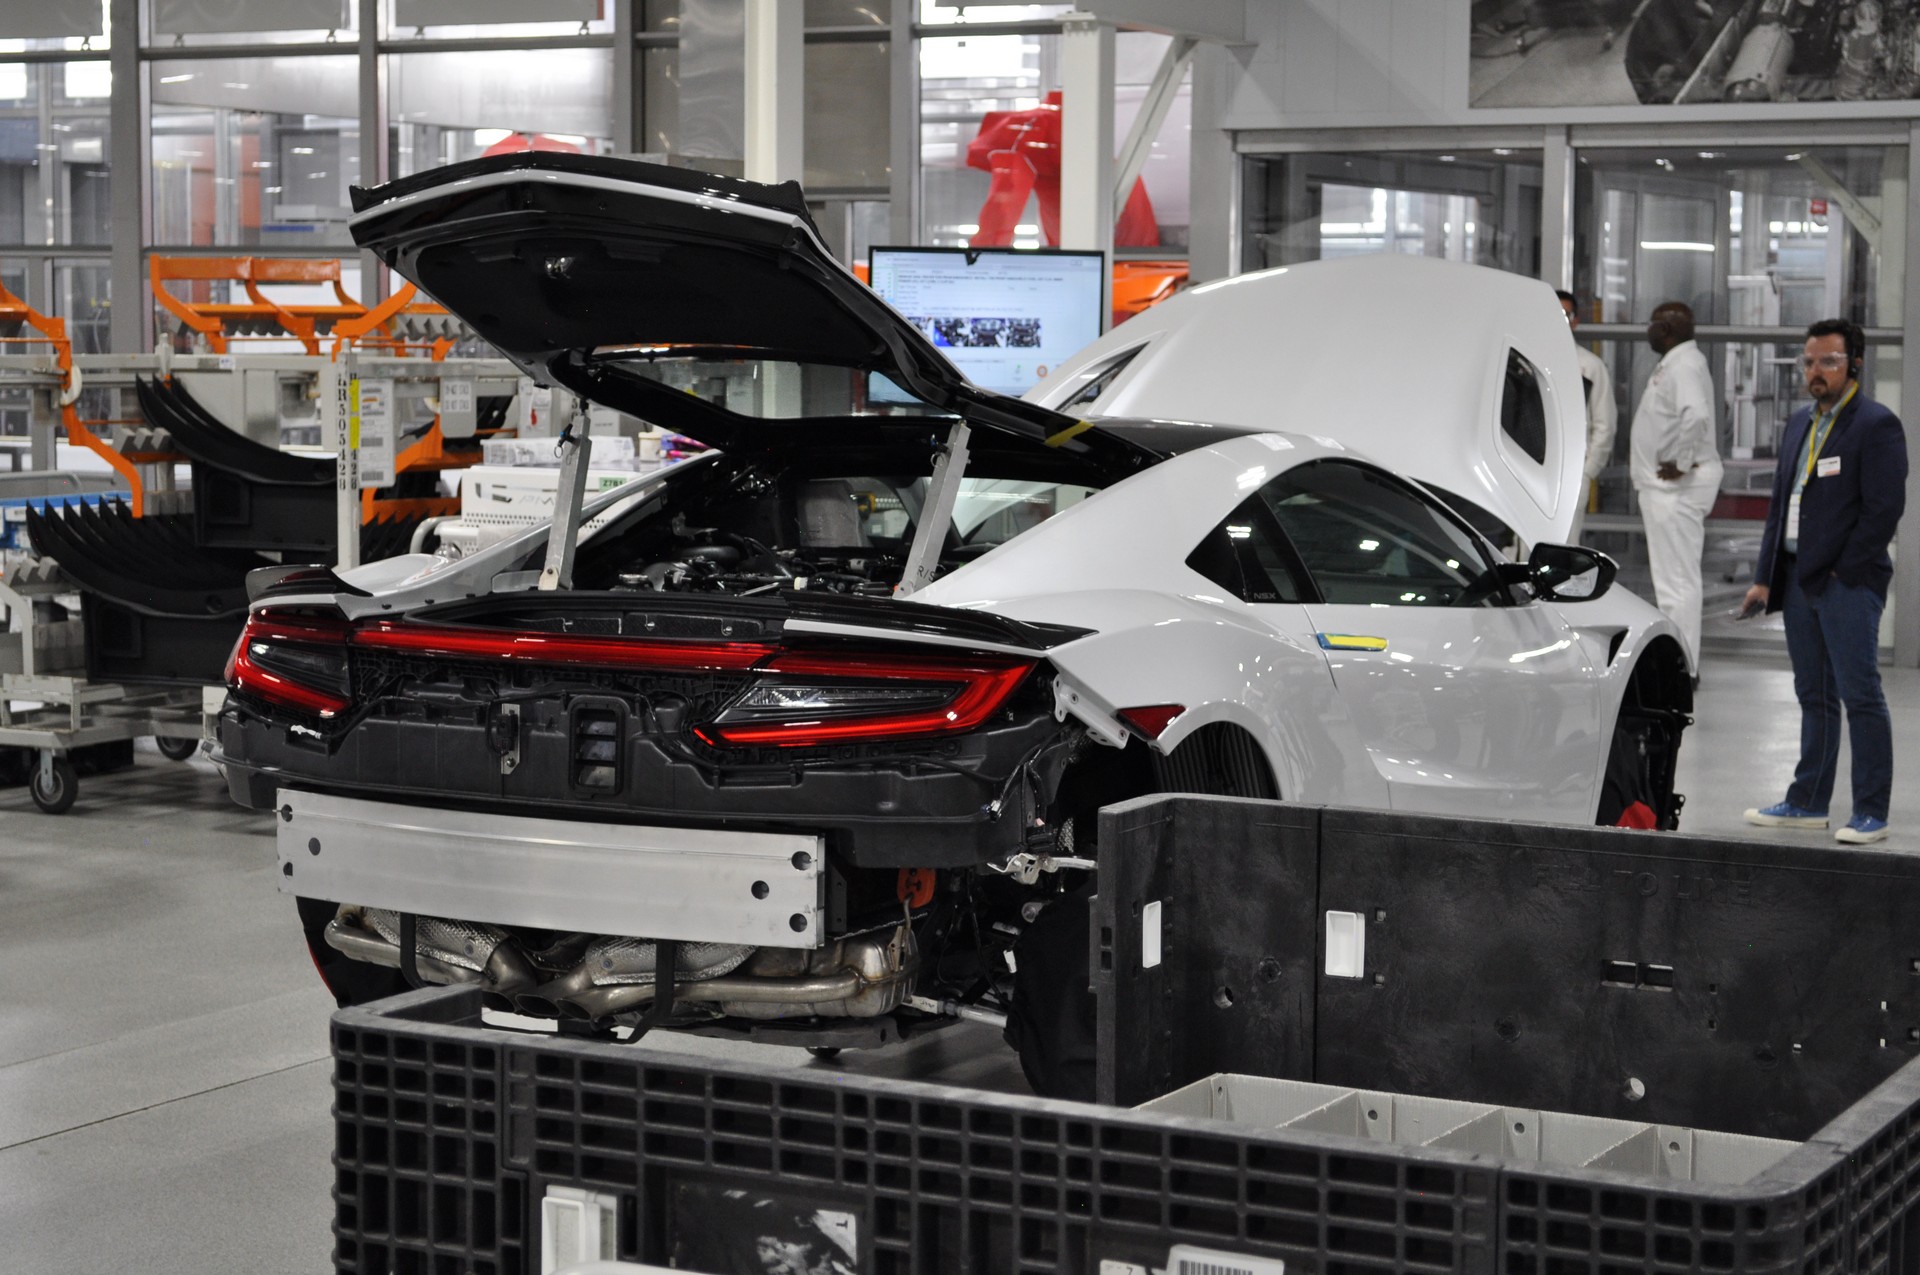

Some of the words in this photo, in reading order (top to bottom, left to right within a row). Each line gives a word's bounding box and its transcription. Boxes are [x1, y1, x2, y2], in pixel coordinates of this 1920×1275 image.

[917, 565, 936, 583] R/S
[1253, 592, 1276, 600] NSX
[1535, 863, 1601, 891] FILL
[1614, 869, 1660, 897] TO
[1675, 874, 1752, 904] LINE
